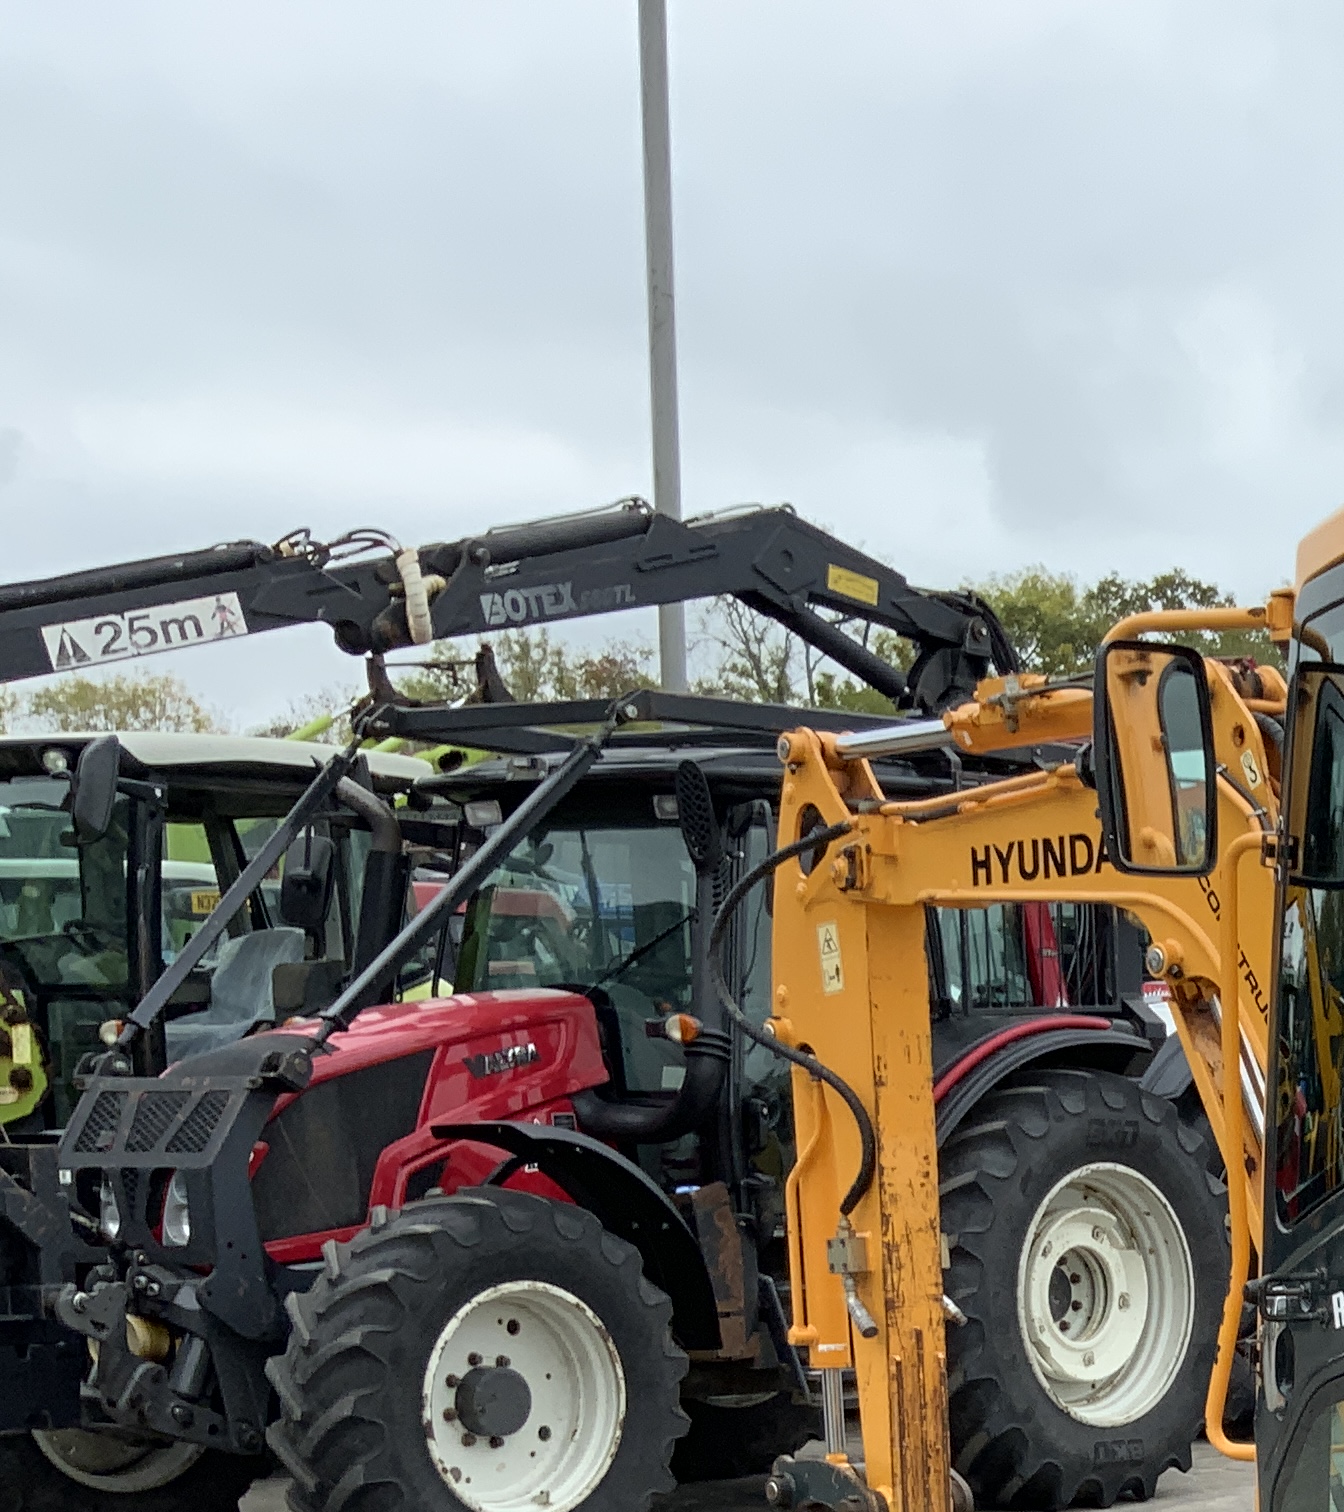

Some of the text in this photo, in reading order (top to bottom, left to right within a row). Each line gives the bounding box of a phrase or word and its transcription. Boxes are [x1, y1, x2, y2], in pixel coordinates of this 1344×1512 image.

[480, 581, 579, 626] BOTEX
[94, 613, 204, 656] 25m
[970, 829, 1113, 887] HYUNDA
